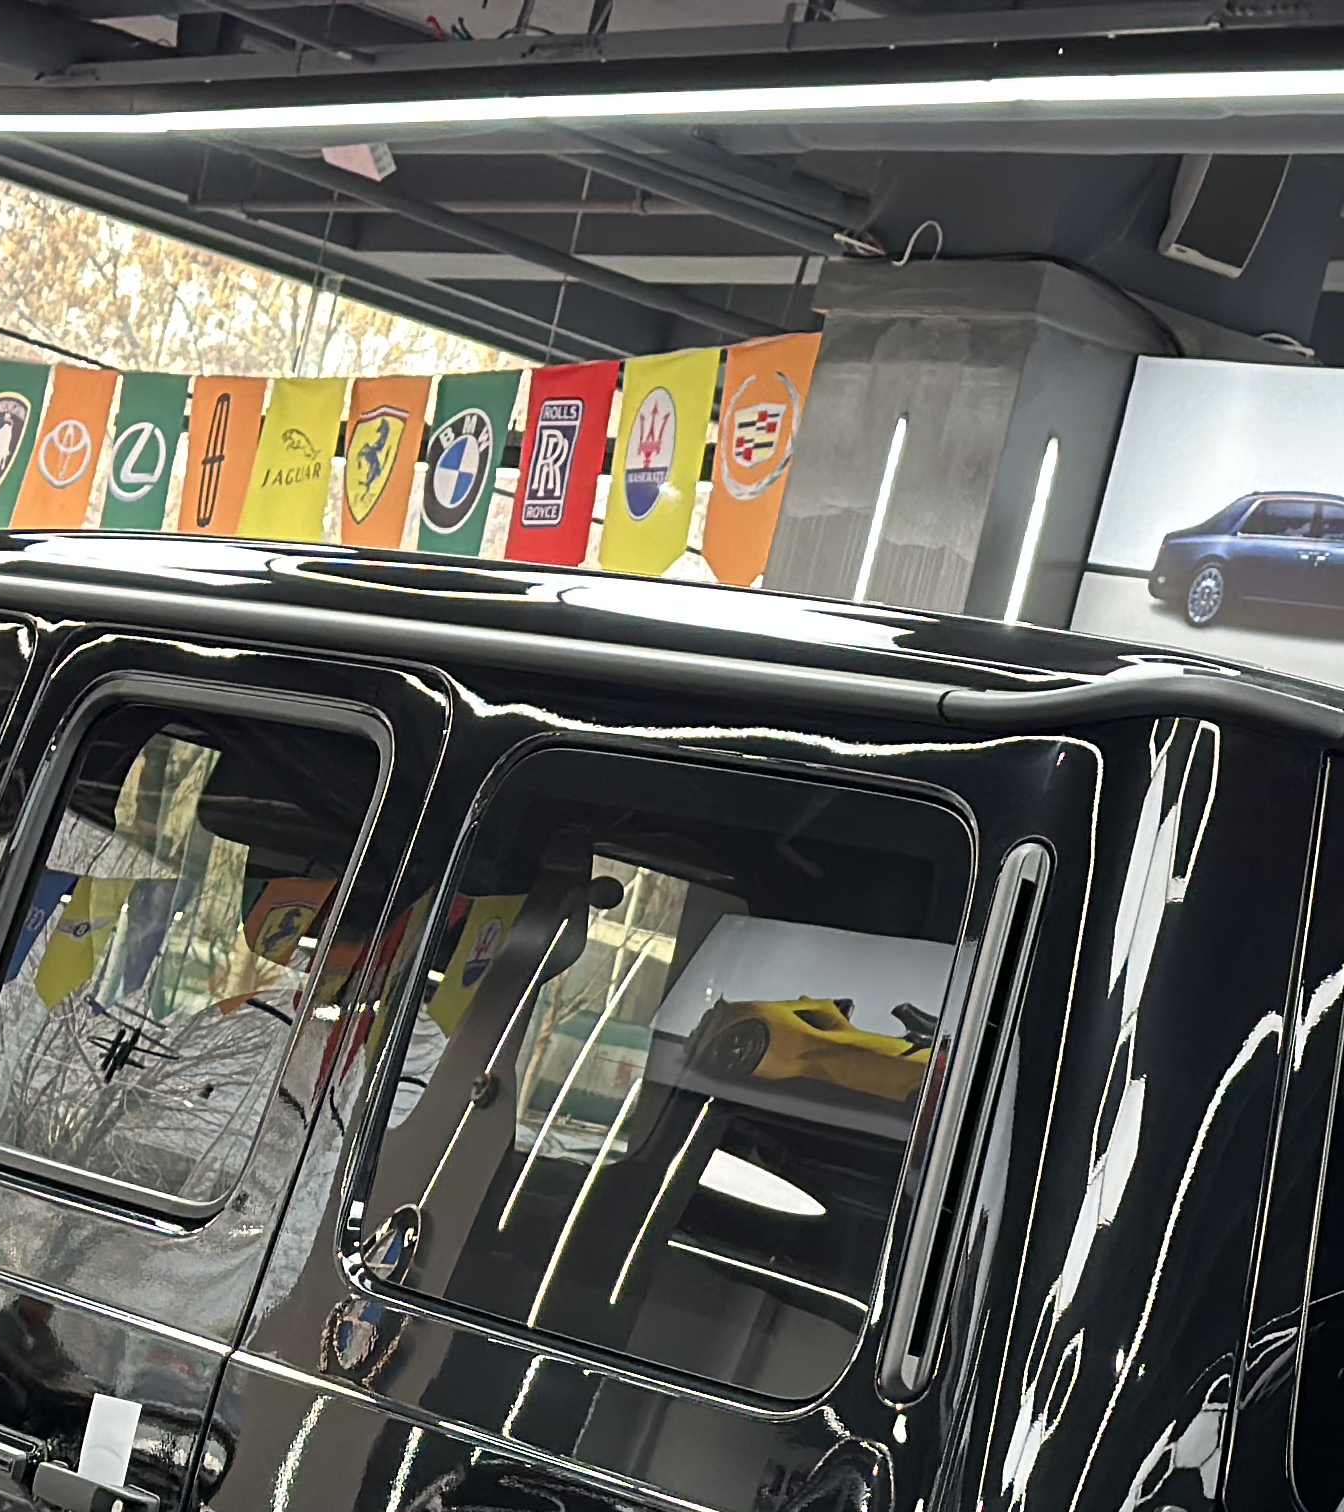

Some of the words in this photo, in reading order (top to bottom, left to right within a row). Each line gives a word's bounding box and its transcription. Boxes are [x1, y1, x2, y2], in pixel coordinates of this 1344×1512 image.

[543, 406, 577, 420] ROLLS
[439, 414, 490, 453] BMW
[261, 462, 322, 488] JAGUAR
[525, 505, 558, 519] ROYCE
